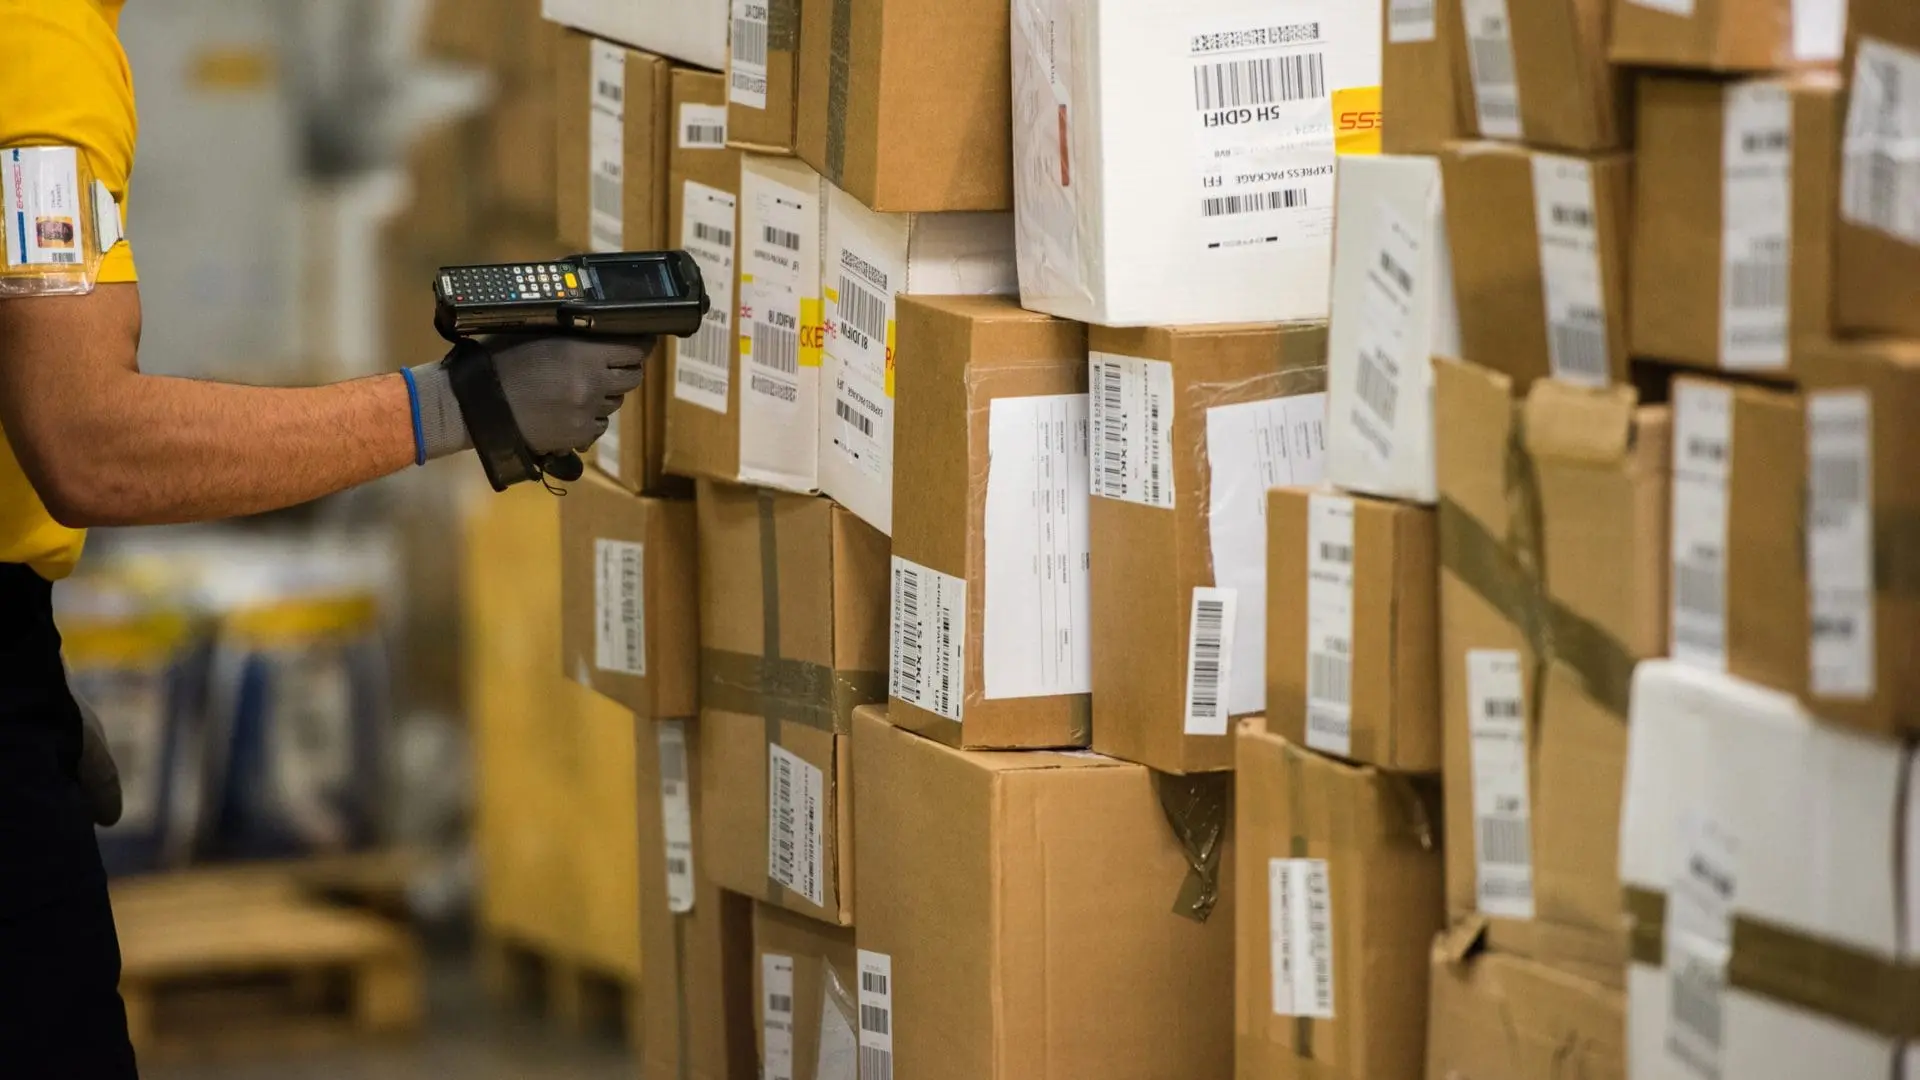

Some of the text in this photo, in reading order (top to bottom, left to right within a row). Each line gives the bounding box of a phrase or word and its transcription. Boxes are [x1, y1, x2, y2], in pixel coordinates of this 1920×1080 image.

[1203, 108, 1252, 128] GDIFI
[1203, 164, 1334, 188] EXPRESS PACKAGE FFI
